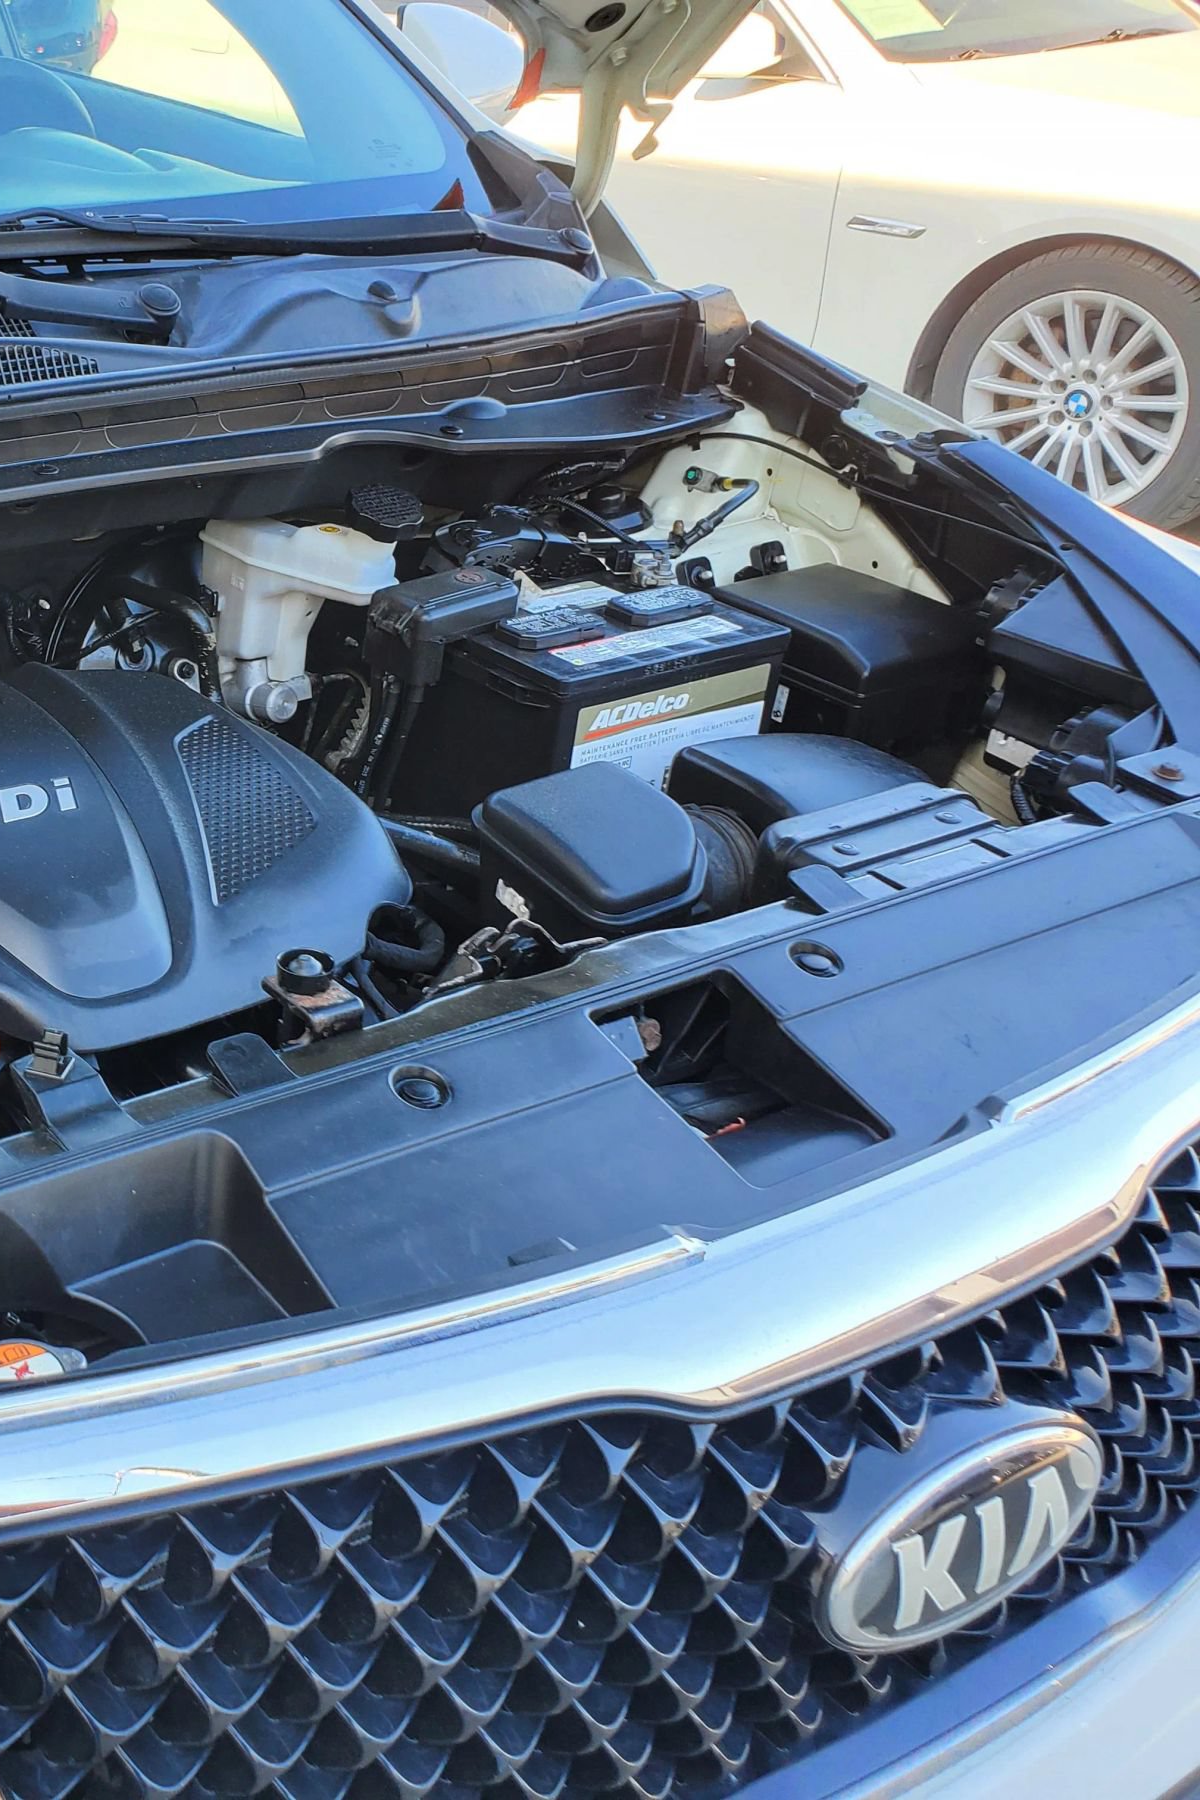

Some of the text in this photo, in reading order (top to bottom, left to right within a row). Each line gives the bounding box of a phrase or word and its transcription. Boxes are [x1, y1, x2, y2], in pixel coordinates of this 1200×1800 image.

[588, 693, 690, 732] ACDelco
[581, 727, 677, 756] MAINTENANCE FREE BATTERY
[891, 1465, 1069, 1630] KIA
